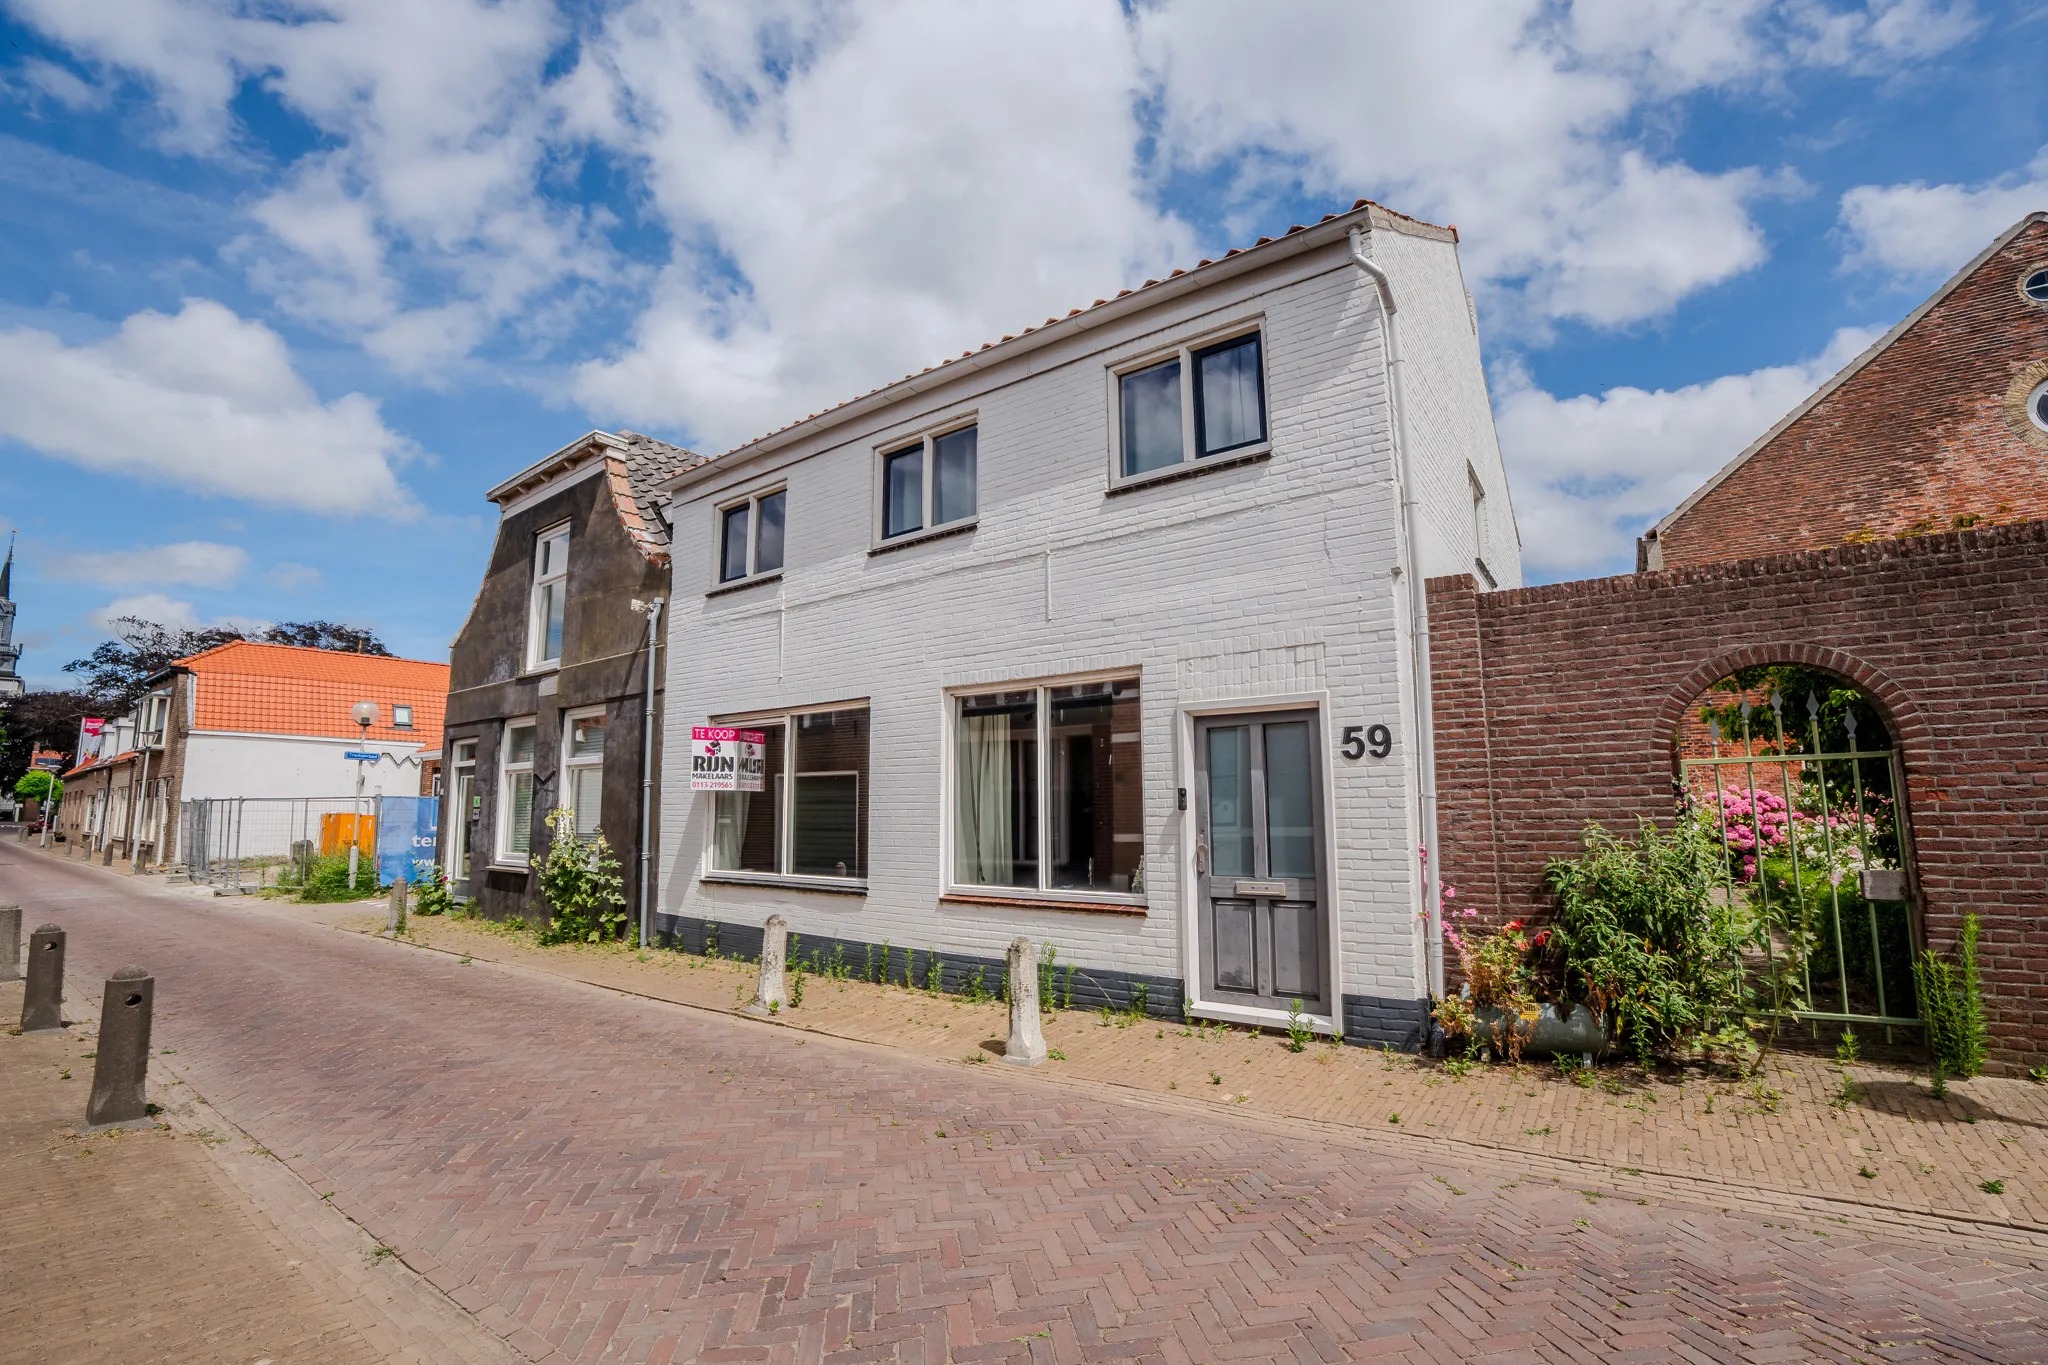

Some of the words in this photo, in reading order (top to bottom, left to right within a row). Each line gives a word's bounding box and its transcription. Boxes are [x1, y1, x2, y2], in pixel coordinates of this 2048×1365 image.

[694, 728, 705, 739] TE
[707, 729, 736, 739] KOOP
[1340, 723, 1392, 760] 59
[692, 755, 735, 772] RIJN
[692, 781, 733, 789] 0113-219565
